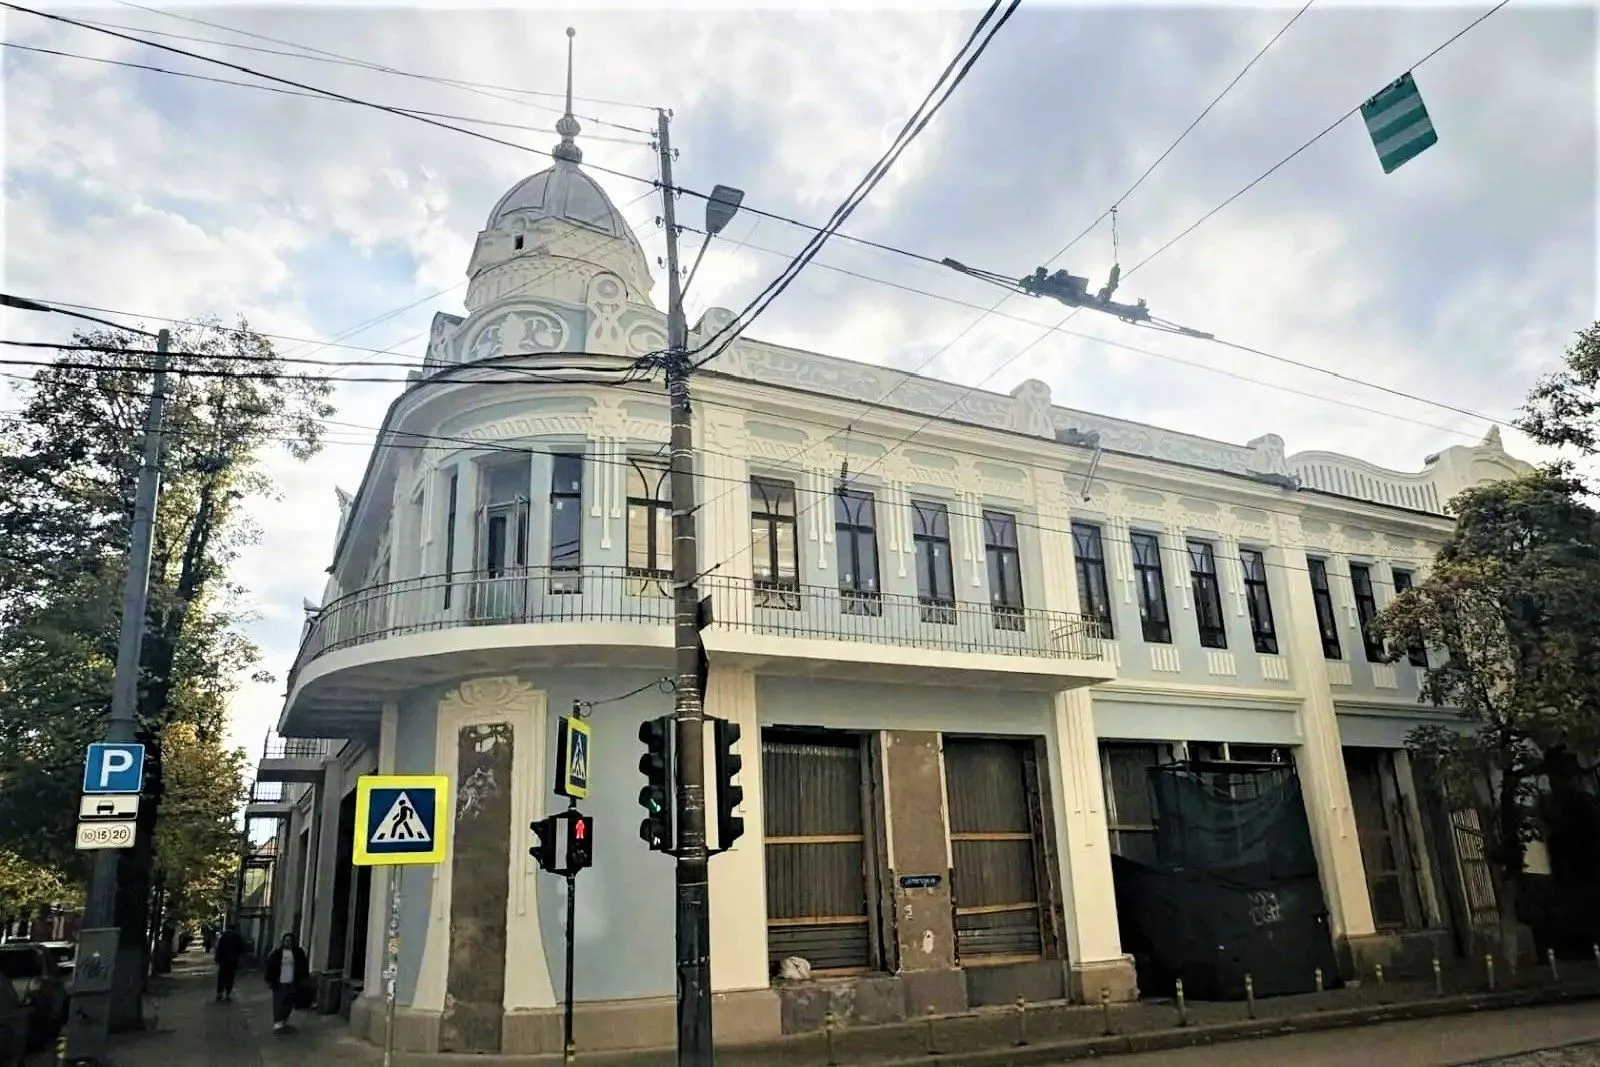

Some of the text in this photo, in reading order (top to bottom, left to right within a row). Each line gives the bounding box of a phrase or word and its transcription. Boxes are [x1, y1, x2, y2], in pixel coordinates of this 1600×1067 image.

[100, 749, 133, 788] P
[84, 829, 127, 840] 10 15 20
